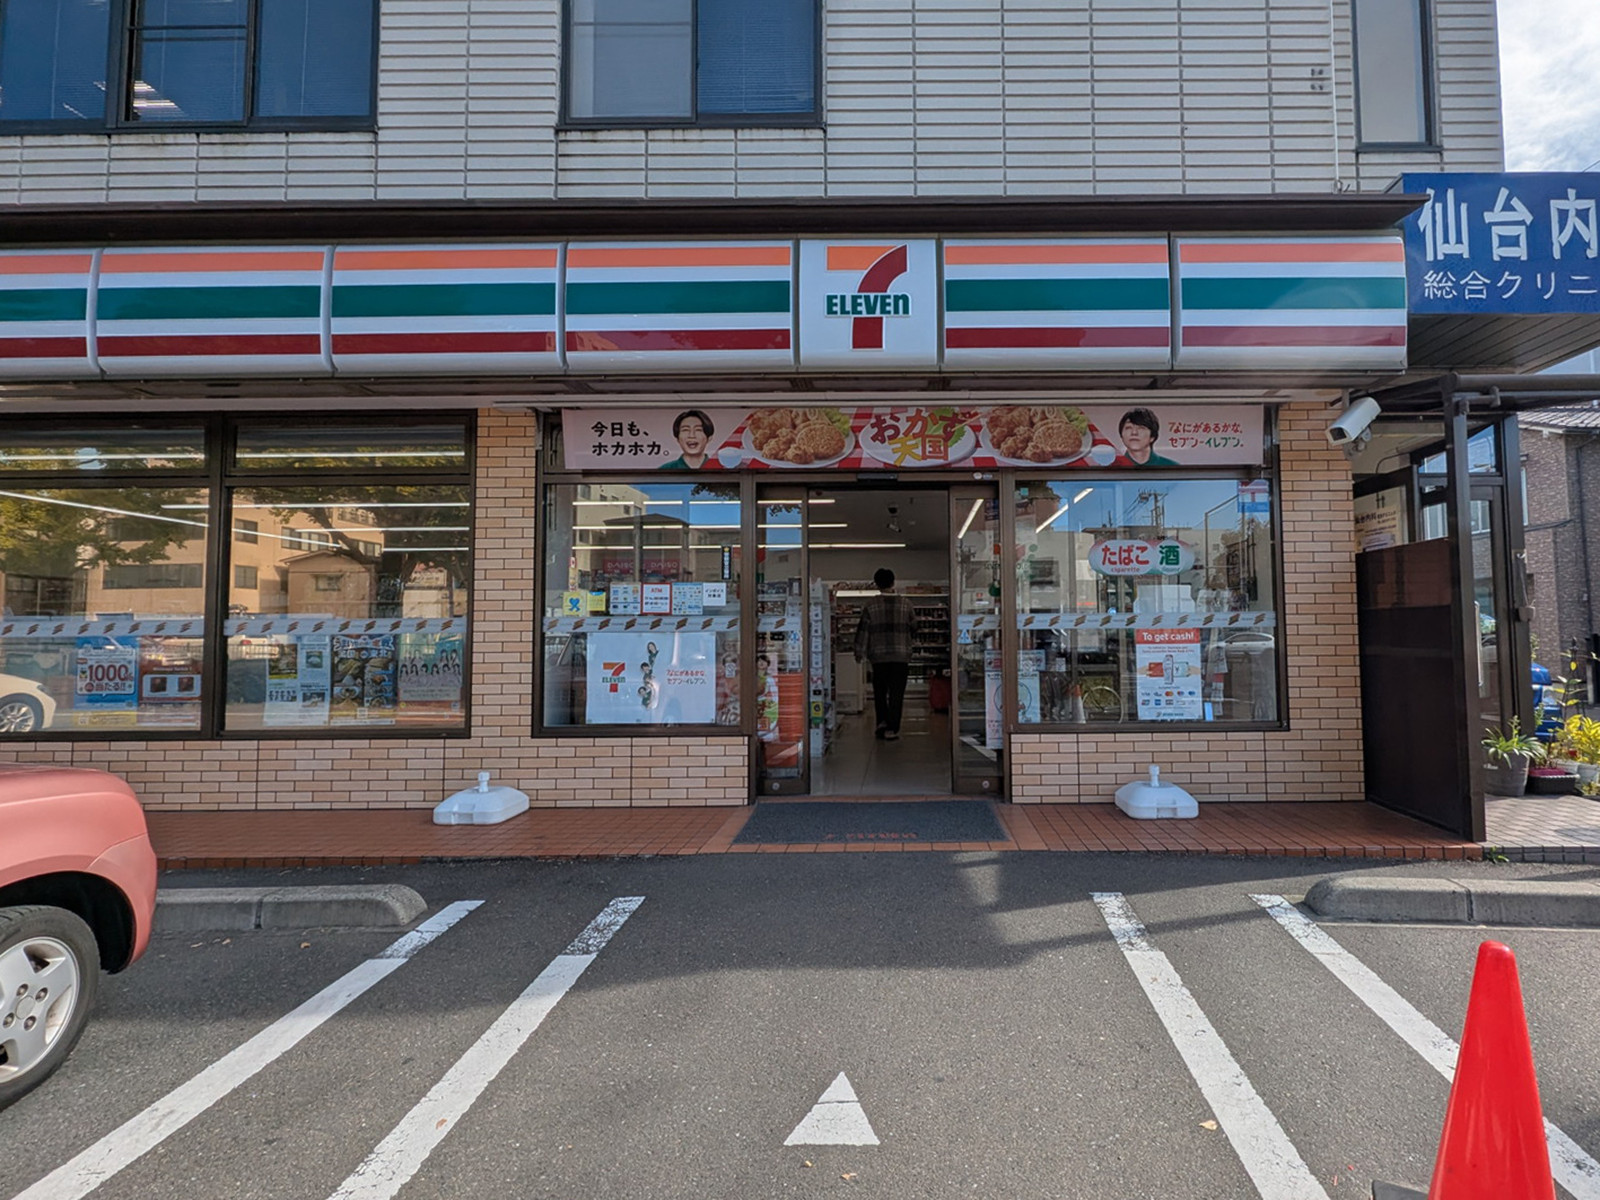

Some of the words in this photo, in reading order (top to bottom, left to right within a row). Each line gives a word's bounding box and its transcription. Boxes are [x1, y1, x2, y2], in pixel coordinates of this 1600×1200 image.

[1418, 187, 1599, 261] 仙台内
[1424, 270, 1598, 300] 総合クリニ
[591, 421, 650, 437] 今日も、
[592, 441, 670, 457] ホカホカ。
[888, 434, 949, 467] 天国
[1101, 545, 1150, 566] たばこ
[1159, 544, 1181, 567] 酒
[1142, 632, 1153, 641] To
[1154, 633, 1169, 643] get
[1170, 631, 1195, 641] cash!
